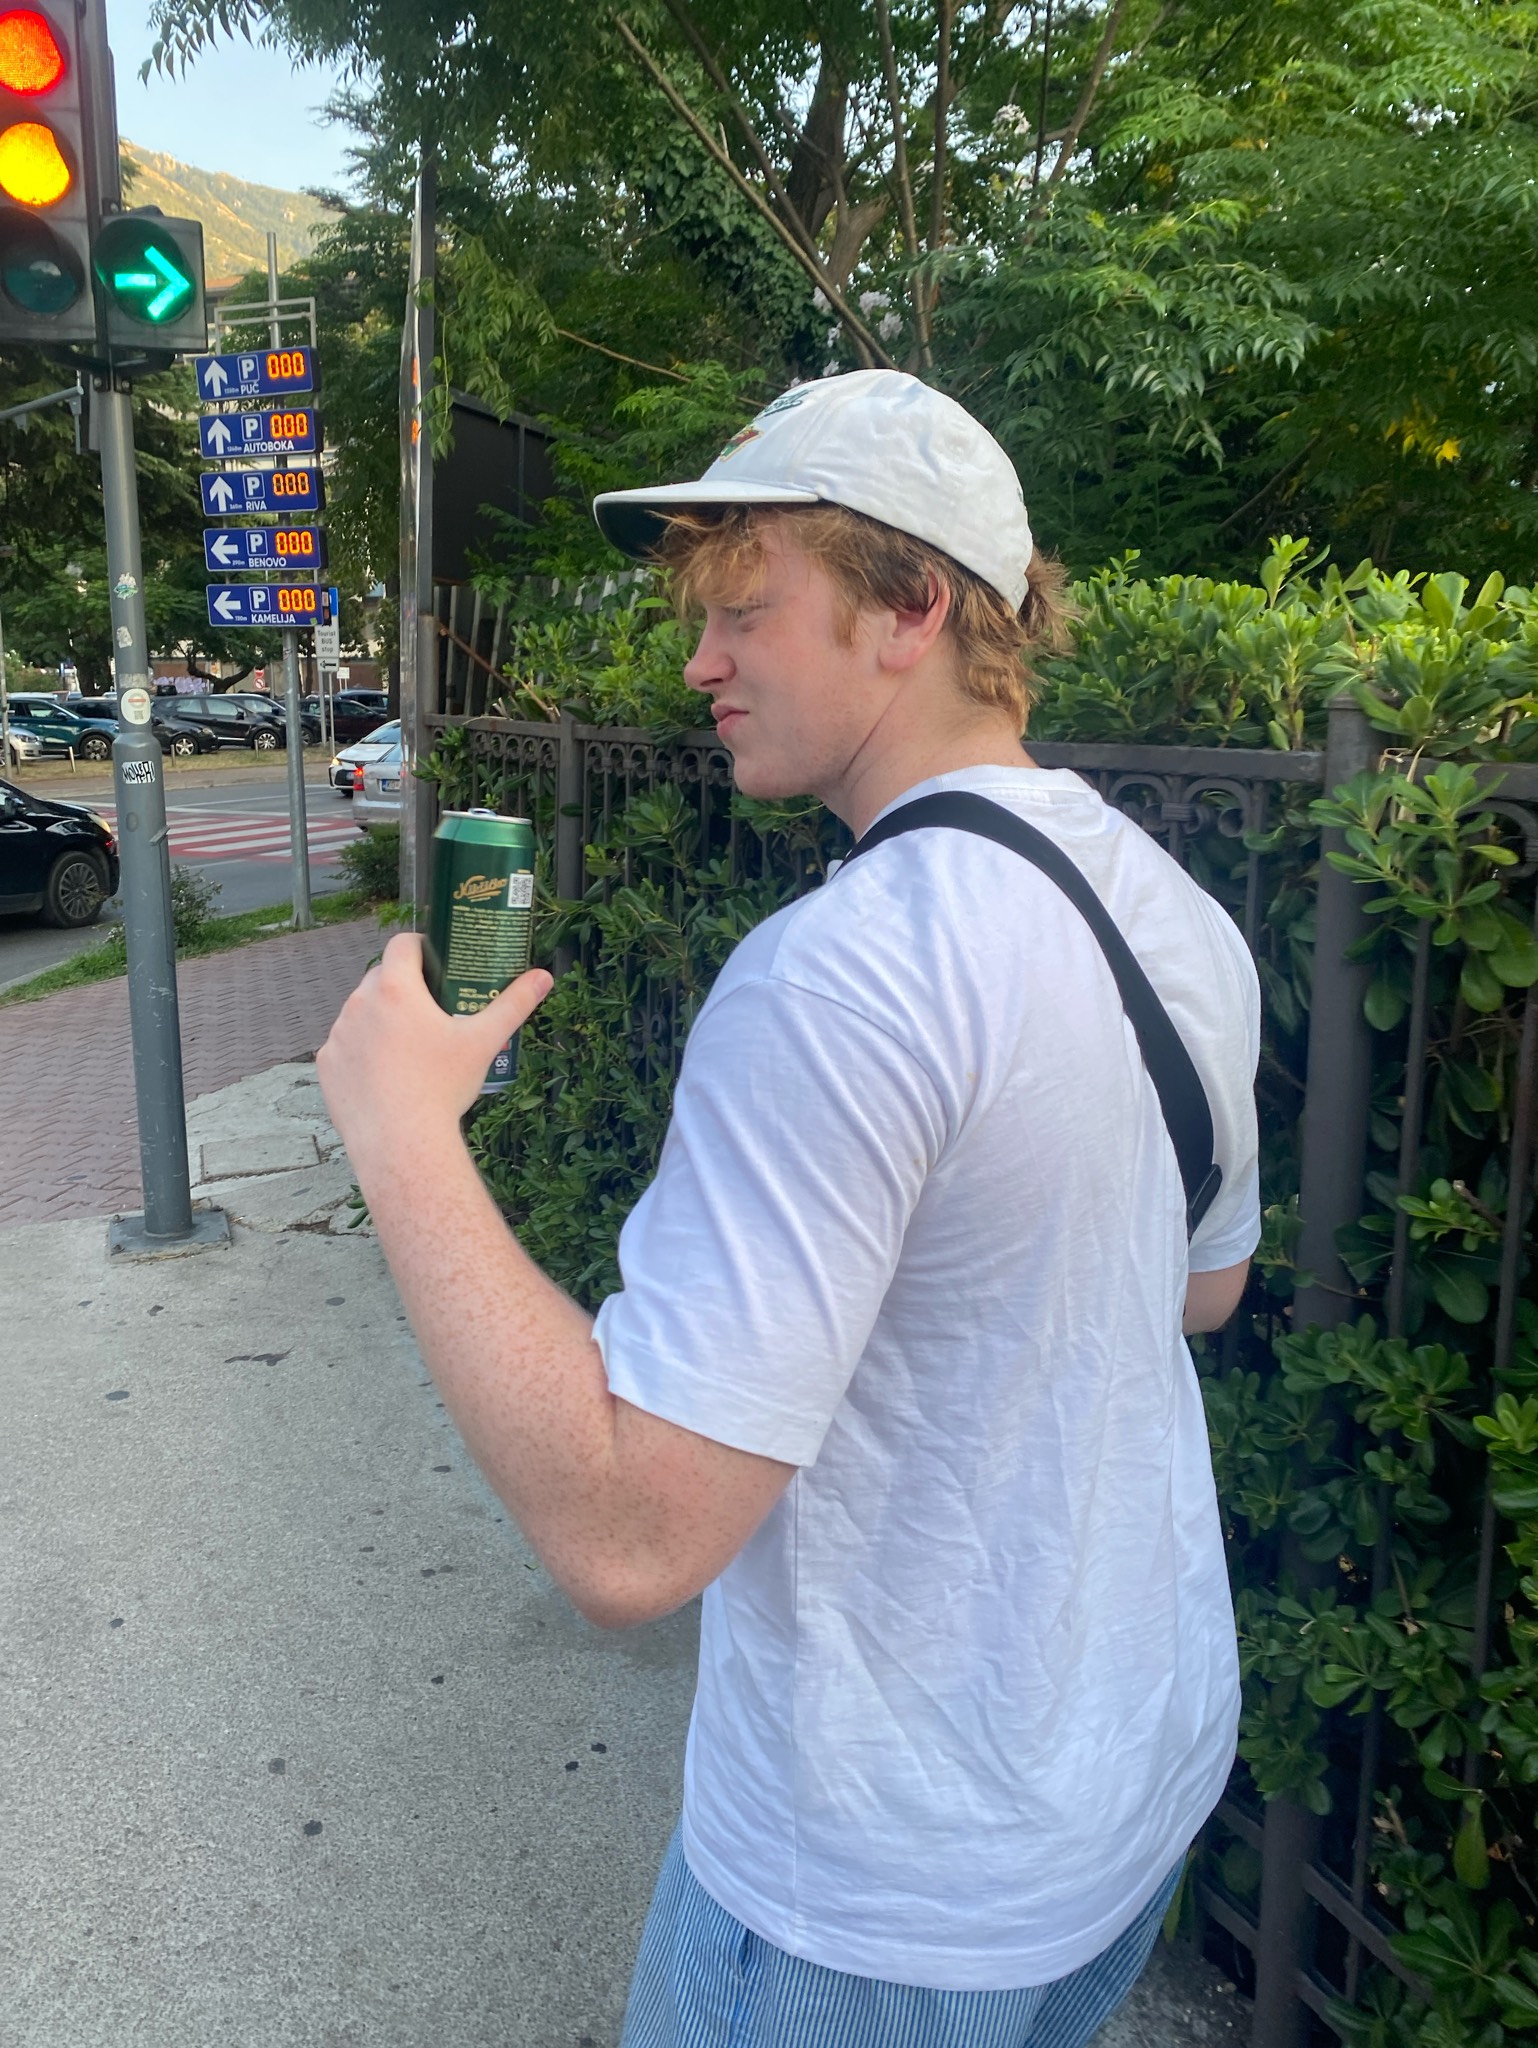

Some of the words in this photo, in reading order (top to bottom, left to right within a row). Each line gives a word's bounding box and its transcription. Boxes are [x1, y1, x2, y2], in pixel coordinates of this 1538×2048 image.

[241, 359, 255, 380] P
[266, 352, 305, 379] 000
[240, 381, 260, 395] PUČ
[245, 418, 259, 439] P
[270, 413, 308, 438] 000
[243, 440, 295, 453] AUTOBOKA
[246, 476, 261, 496] P
[272, 472, 309, 496] 000
[245, 500, 267, 511] RIVA
[250, 533, 264, 553] P
[275, 531, 313, 554] 000
[248, 556, 287, 568] BENOVO
[252, 590, 266, 609] P
[278, 588, 316, 611] 000
[251, 613, 296, 624] KAMELIJA
